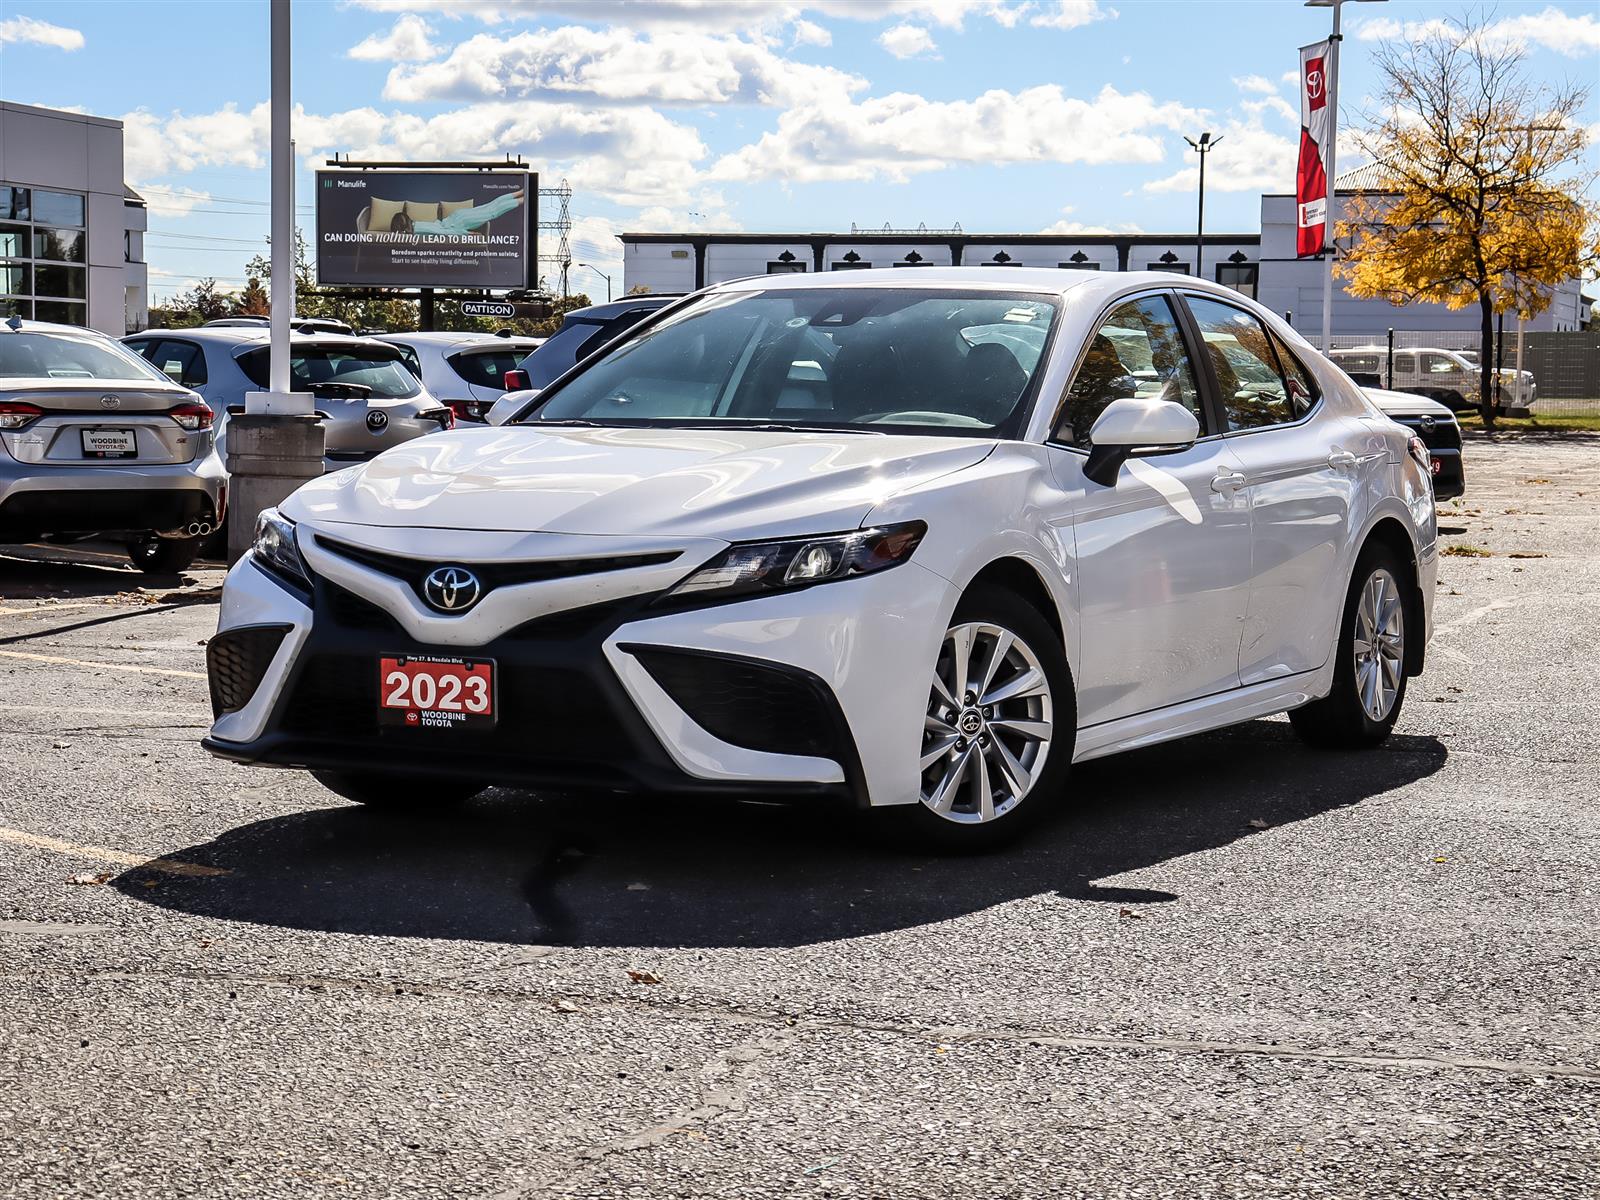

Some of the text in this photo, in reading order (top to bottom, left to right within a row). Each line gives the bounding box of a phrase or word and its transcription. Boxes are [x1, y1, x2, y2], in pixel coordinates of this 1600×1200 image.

[337, 180, 367, 188] Manulife
[324, 230, 520, 246] CAN DOING nothing LEAD TO BRILLIANCE?
[465, 304, 511, 314] PATTISON
[386, 671, 488, 712] 2023
[421, 711, 466, 720] WOODBINE
[421, 719, 452, 727] TOYOTA
